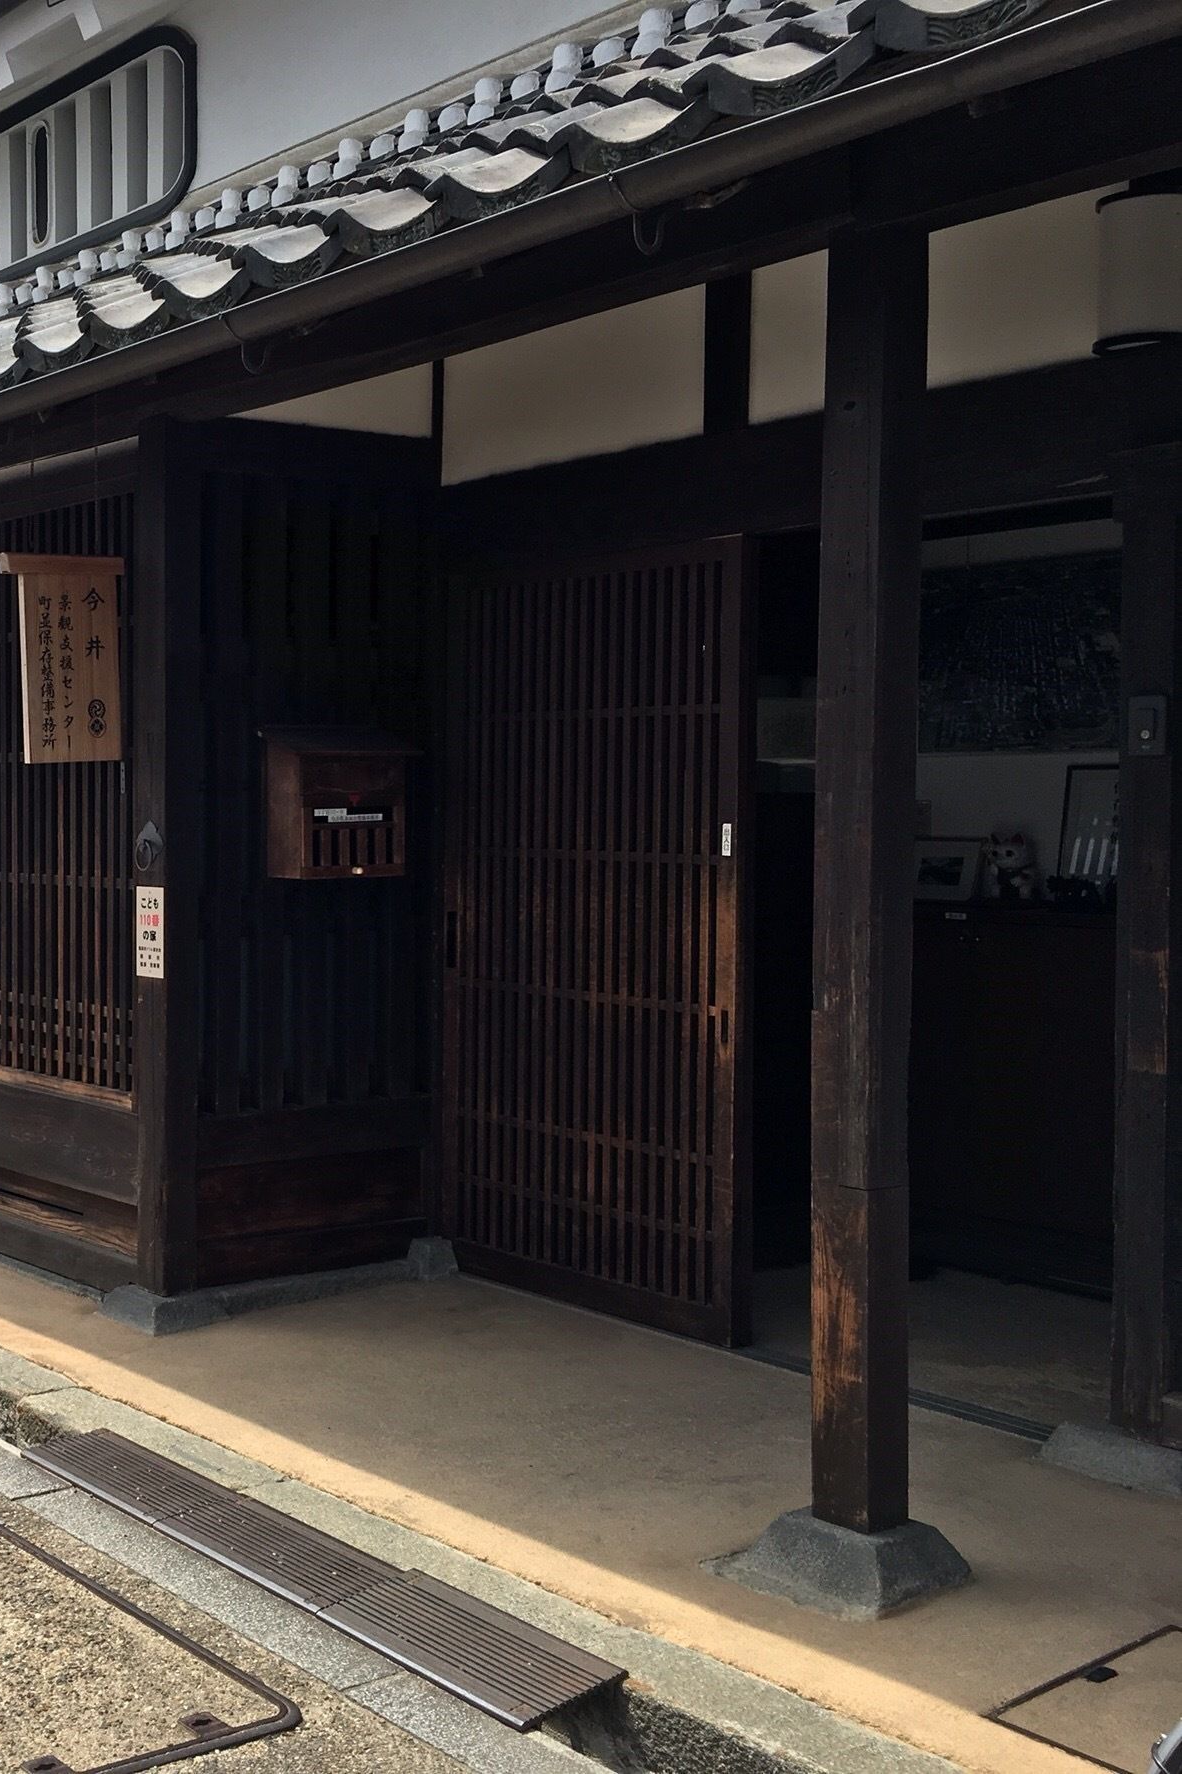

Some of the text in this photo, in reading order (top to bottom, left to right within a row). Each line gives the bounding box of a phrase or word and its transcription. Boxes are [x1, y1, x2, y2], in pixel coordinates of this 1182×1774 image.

[37, 595, 57, 750] 町並保存整備事務所
[57, 593, 75, 749] 景観支援センター
[82, 587, 105, 660] 今井
[140, 898, 159, 909] こども
